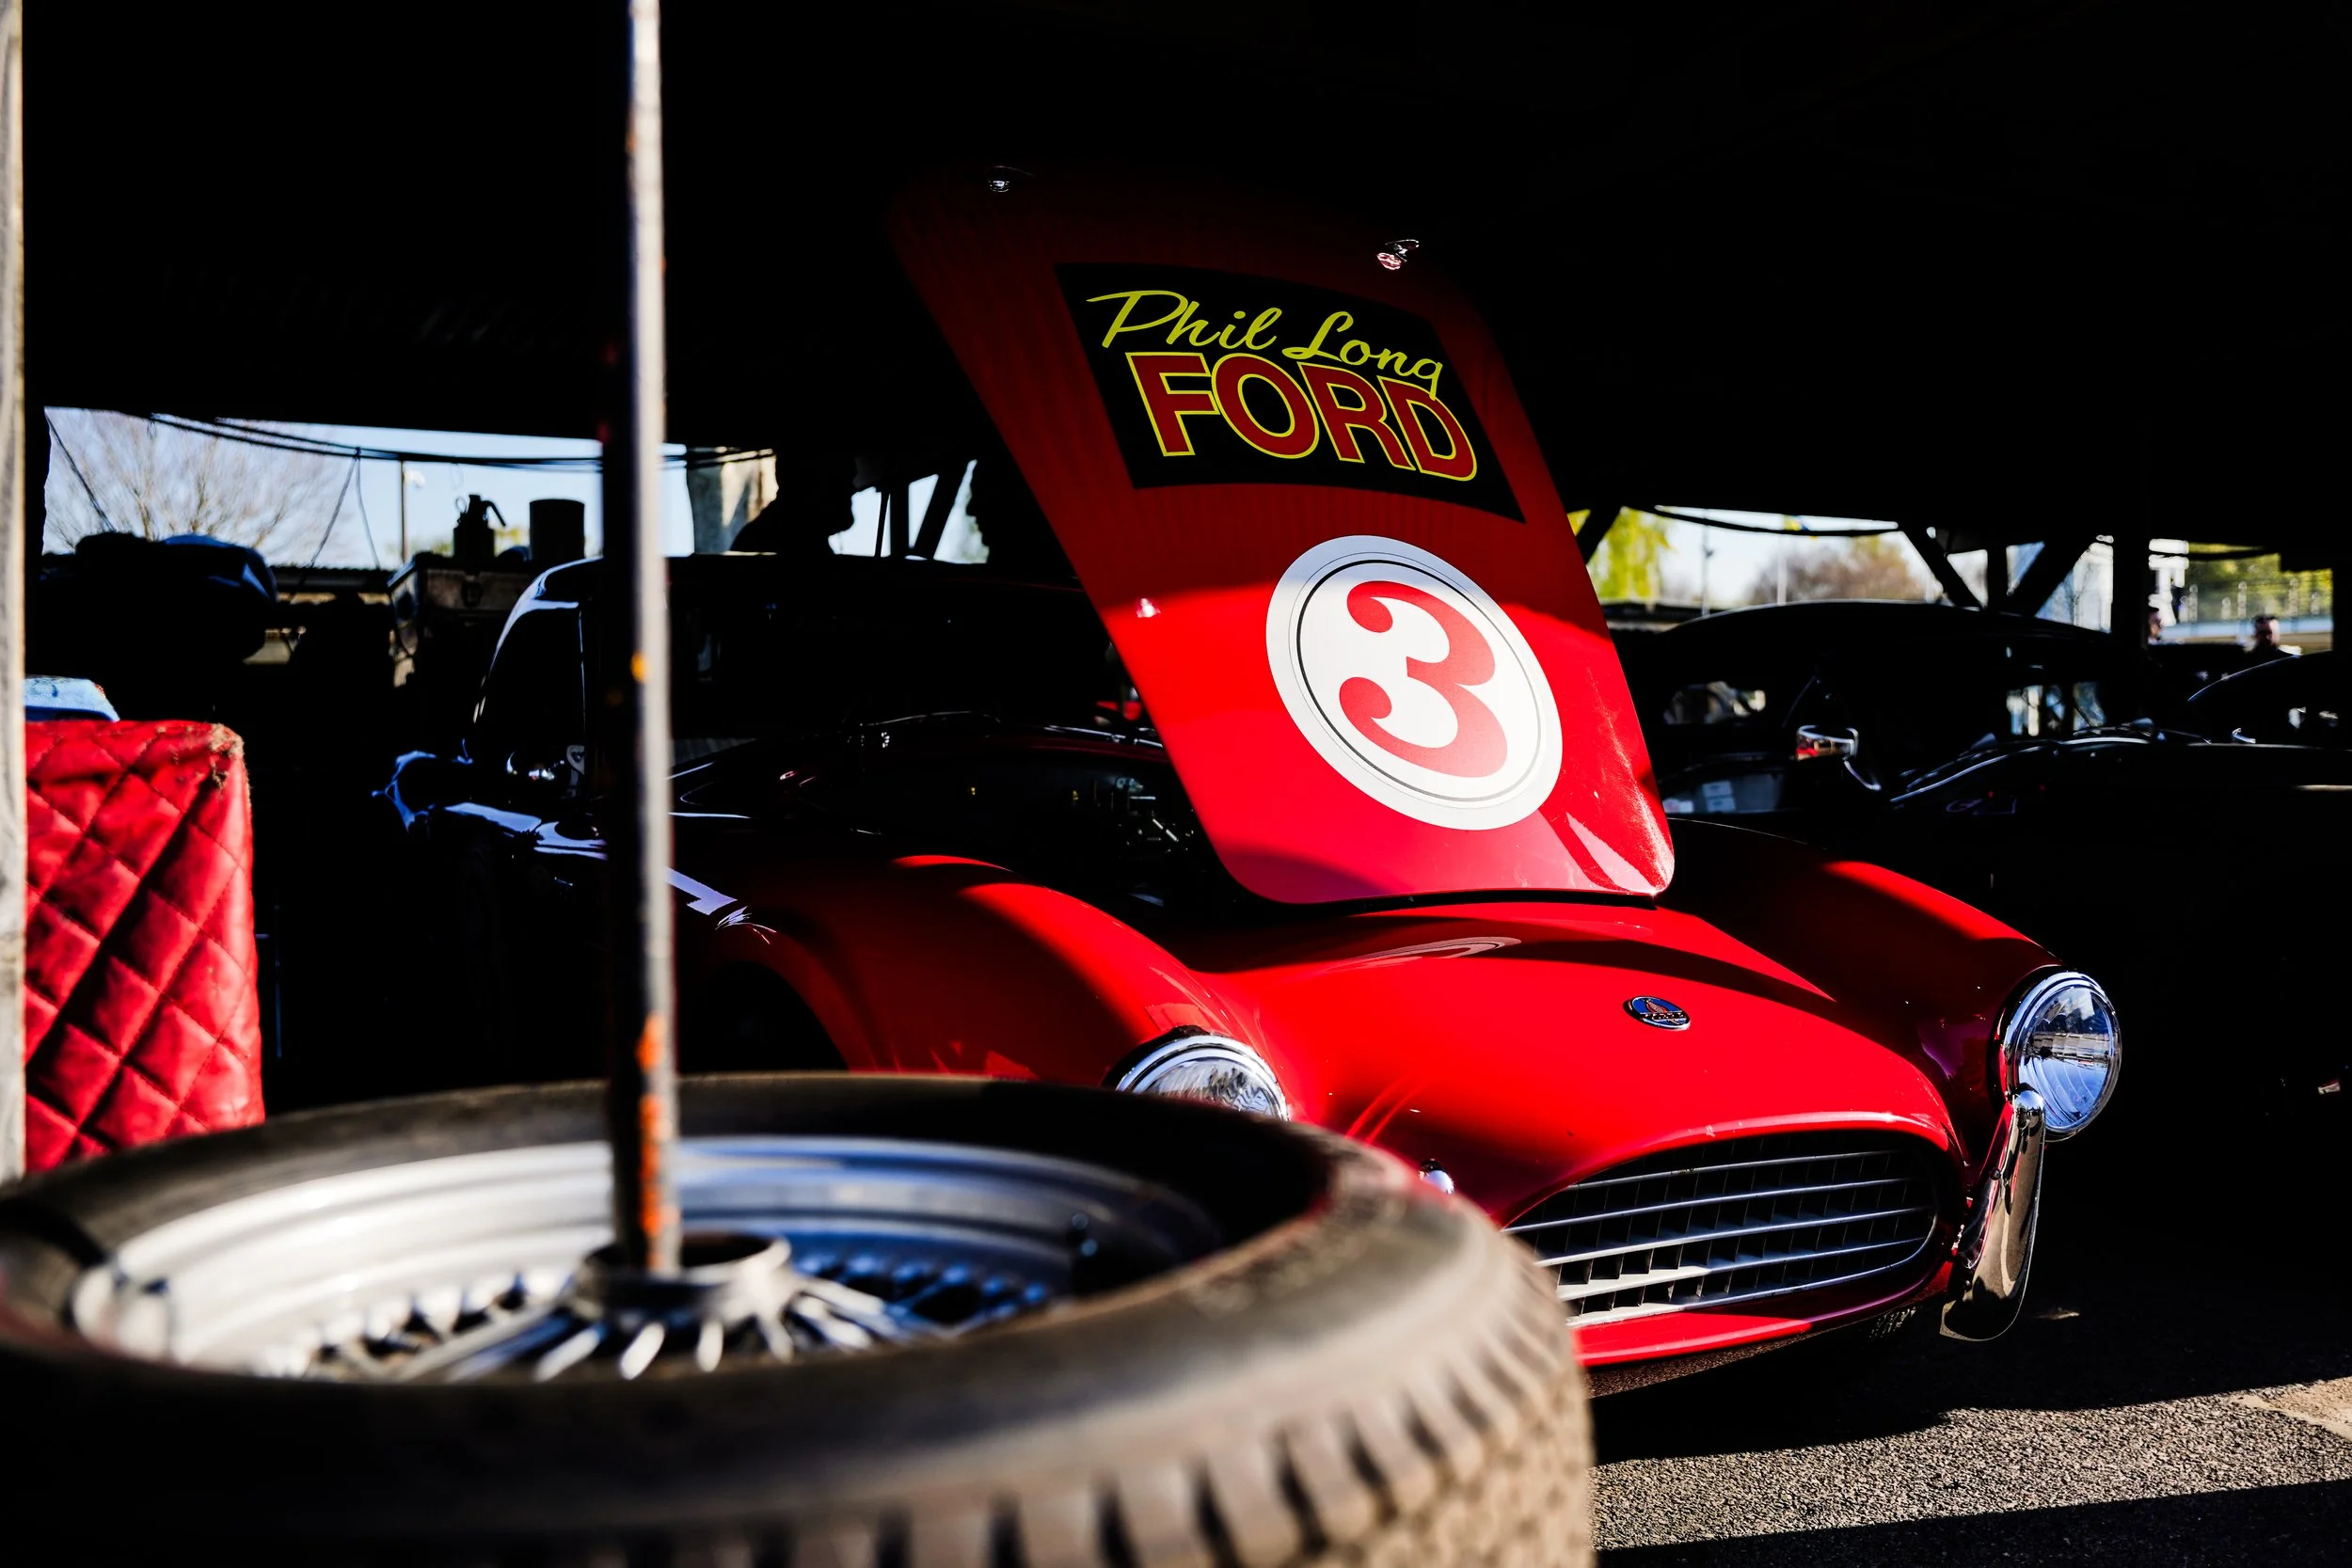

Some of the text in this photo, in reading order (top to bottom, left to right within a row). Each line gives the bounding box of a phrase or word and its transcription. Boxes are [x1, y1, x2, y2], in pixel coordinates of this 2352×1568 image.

[1086, 290, 1443, 401] Phil Long
[1125, 351, 1478, 482] FORD
[1339, 580, 1508, 778] 3
